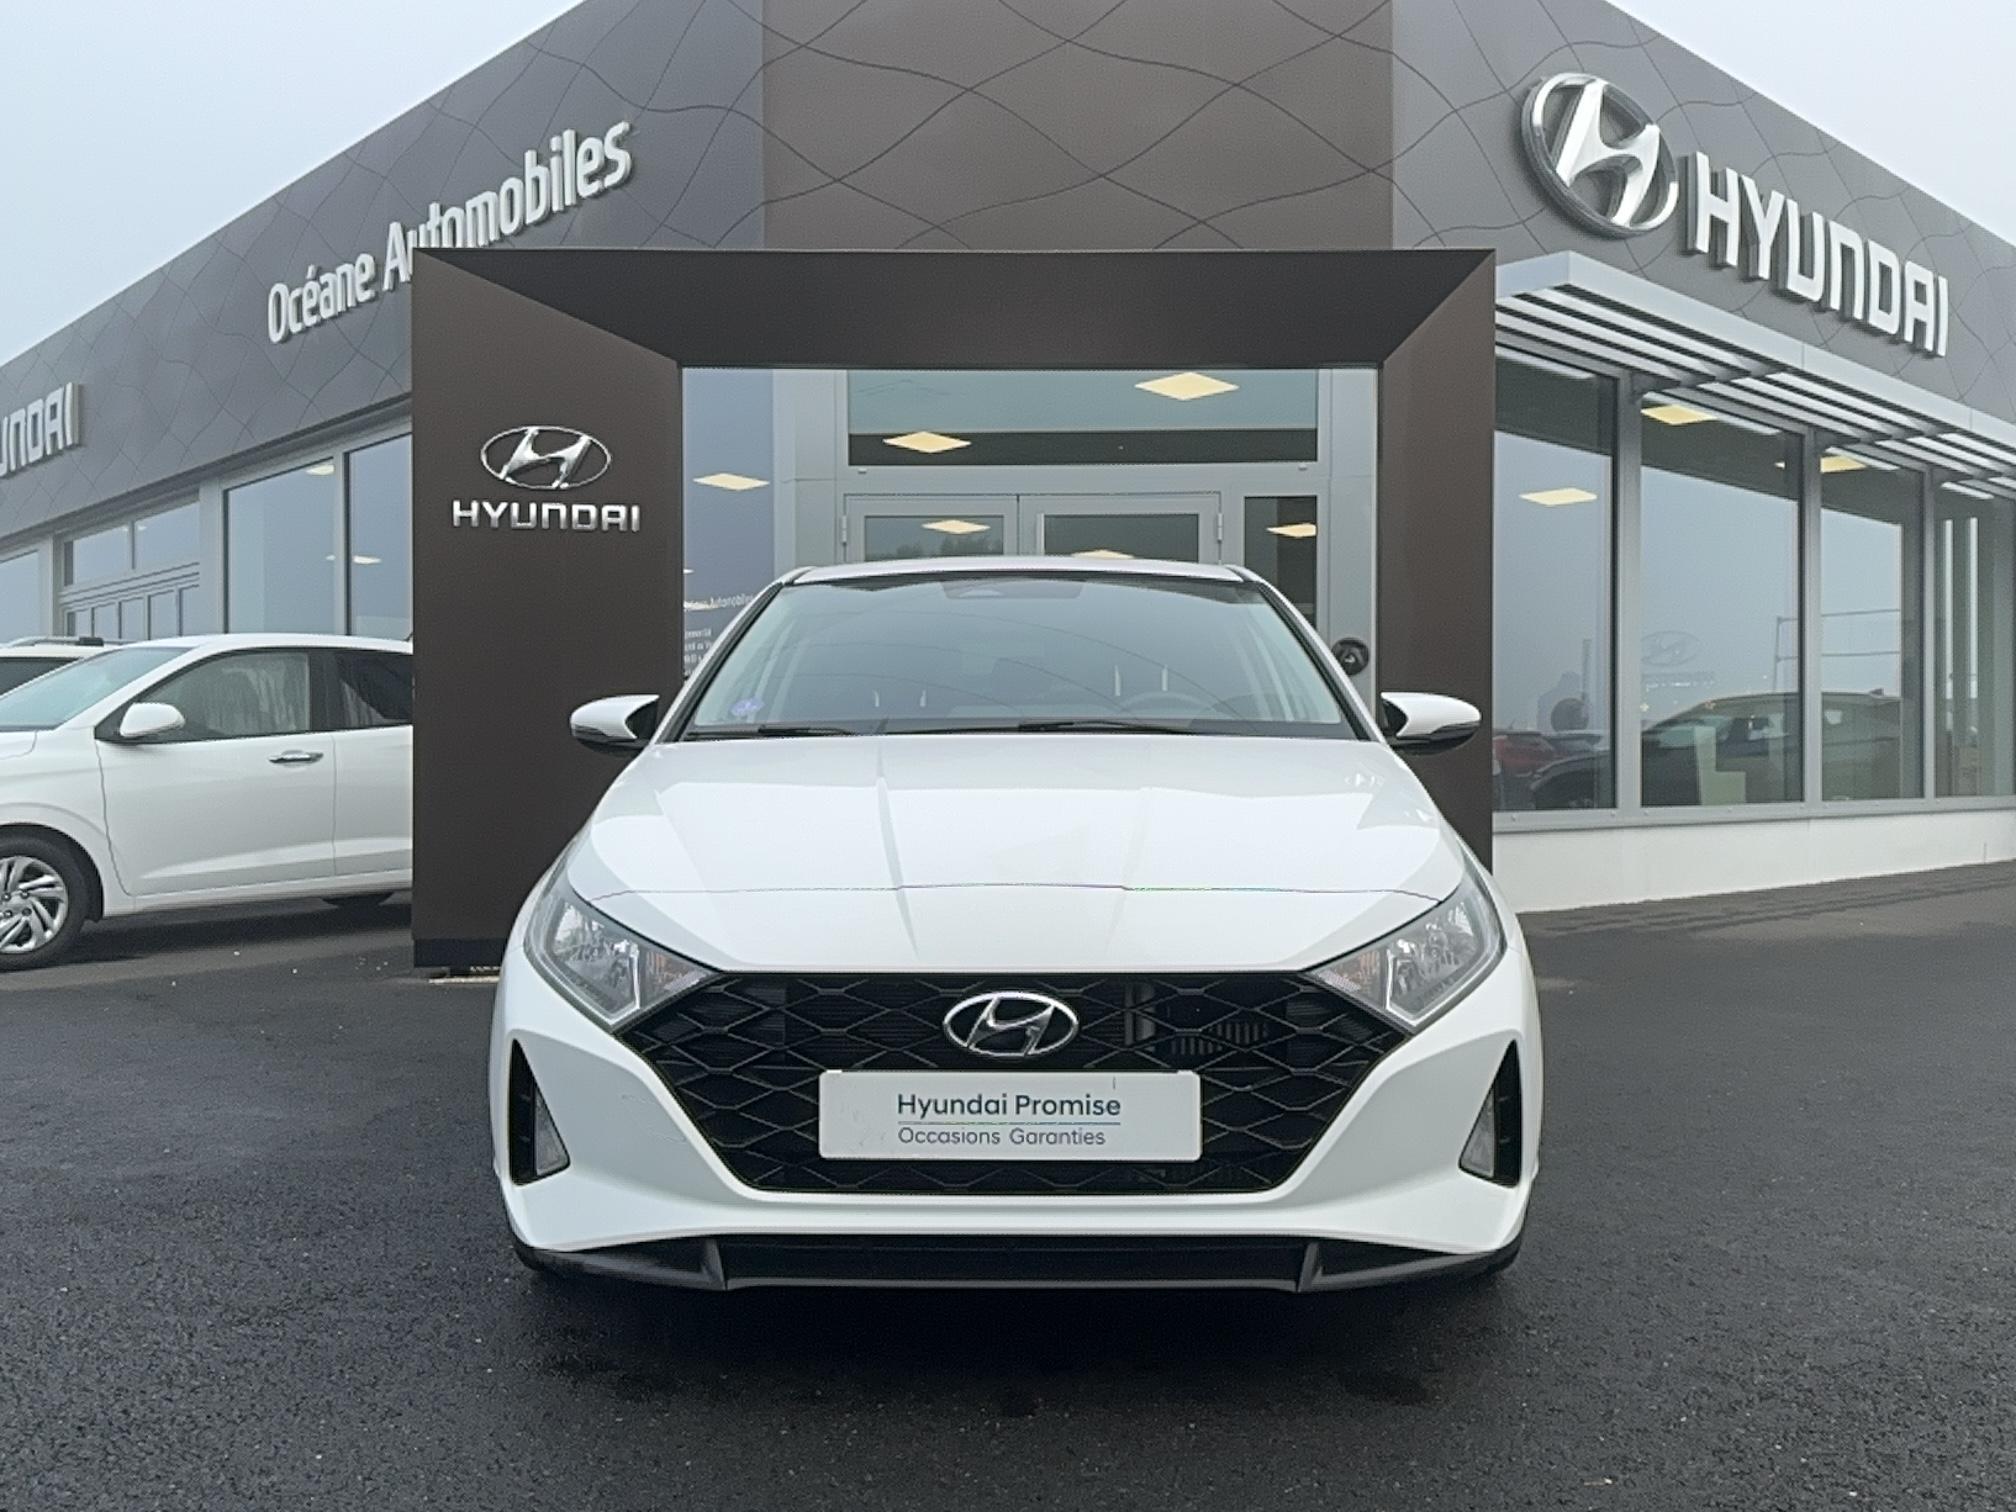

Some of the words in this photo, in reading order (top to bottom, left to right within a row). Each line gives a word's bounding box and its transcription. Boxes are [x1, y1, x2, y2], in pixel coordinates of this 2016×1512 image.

[266, 252, 376, 344] Océane
[382, 120, 632, 292] Automobiles
[1686, 151, 1949, 358] HYUNDAI
[452, 500, 641, 533] HYUNDAI
[897, 1093, 1008, 1120] Hyundai
[1014, 1093, 1121, 1116] Promise
[897, 1127, 1001, 1146] Occasions
[1008, 1127, 1106, 1146] Garanties
